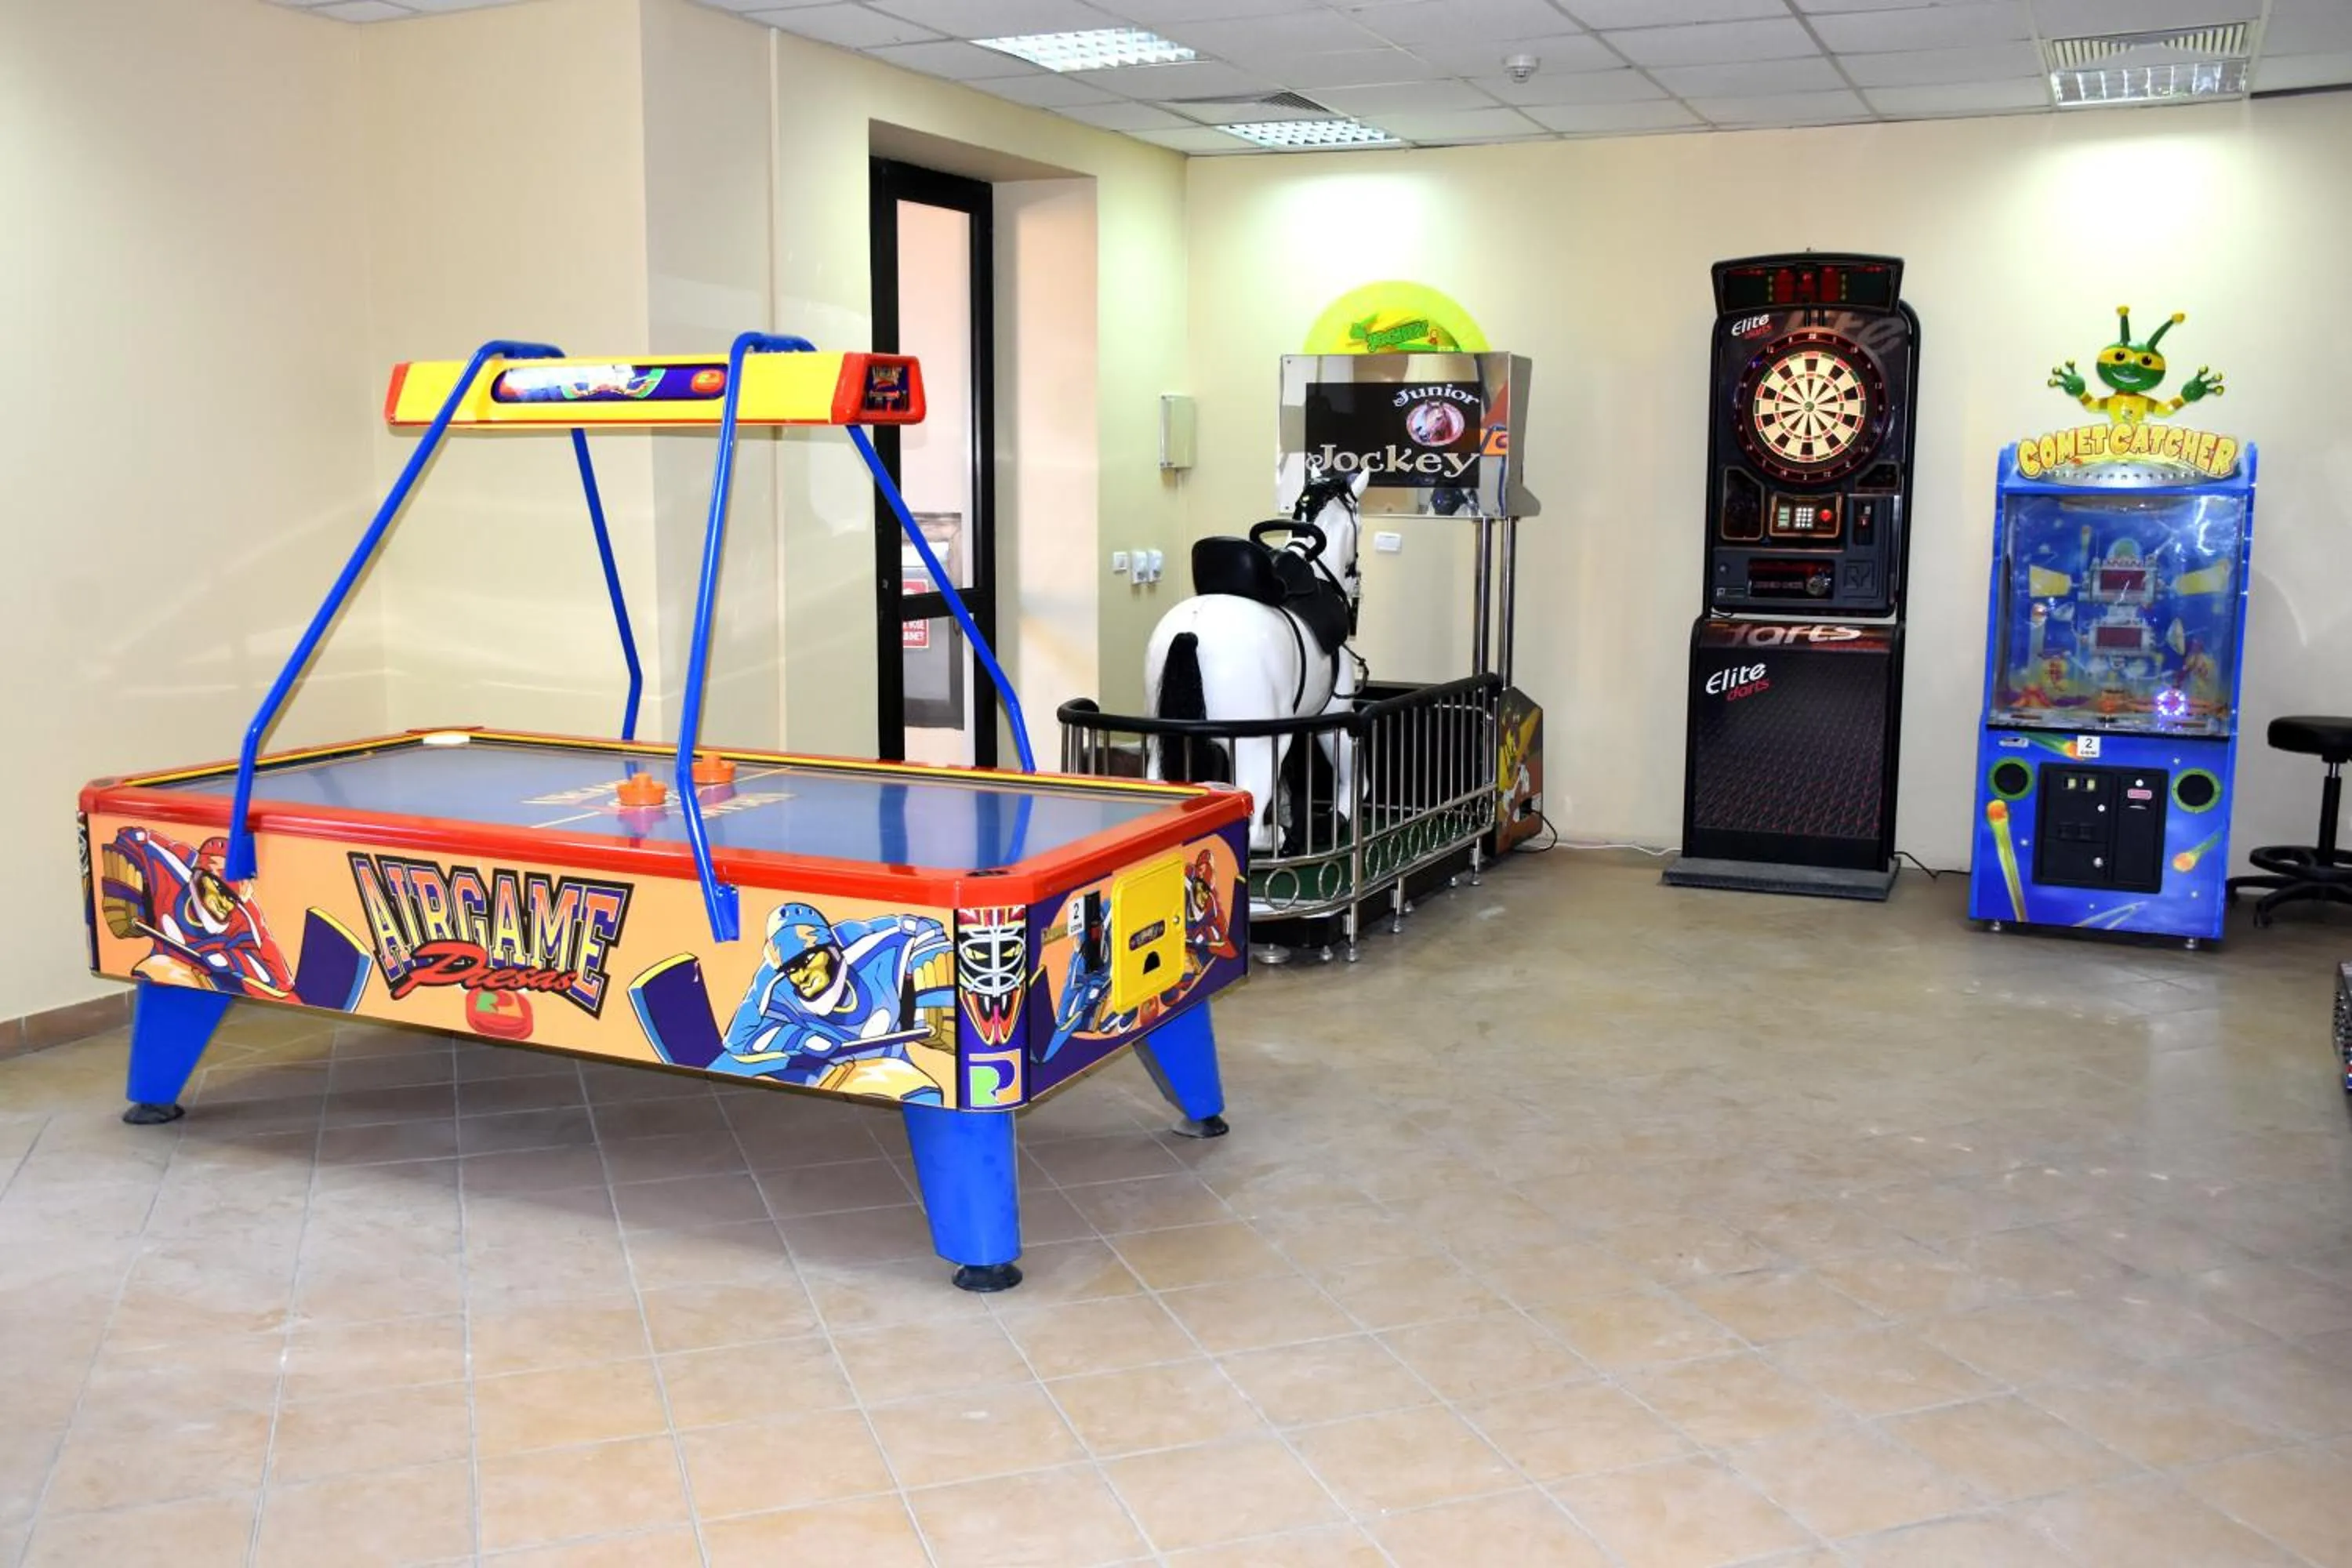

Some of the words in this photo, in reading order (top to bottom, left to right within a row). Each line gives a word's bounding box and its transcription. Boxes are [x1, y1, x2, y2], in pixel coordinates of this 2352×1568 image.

[1731, 314, 1770, 336] Elite
[1392, 383, 1480, 407] Junior
[1305, 444, 1479, 477] Jockey
[2018, 424, 2109, 477] COMET
[2108, 423, 2238, 477] CATCHER
[1705, 662, 1766, 695] Elite
[1727, 679, 1770, 701] darts
[2085, 738, 2092, 749] 2
[1073, 902, 1080, 920] 2
[348, 851, 633, 1019] AIRGAME
